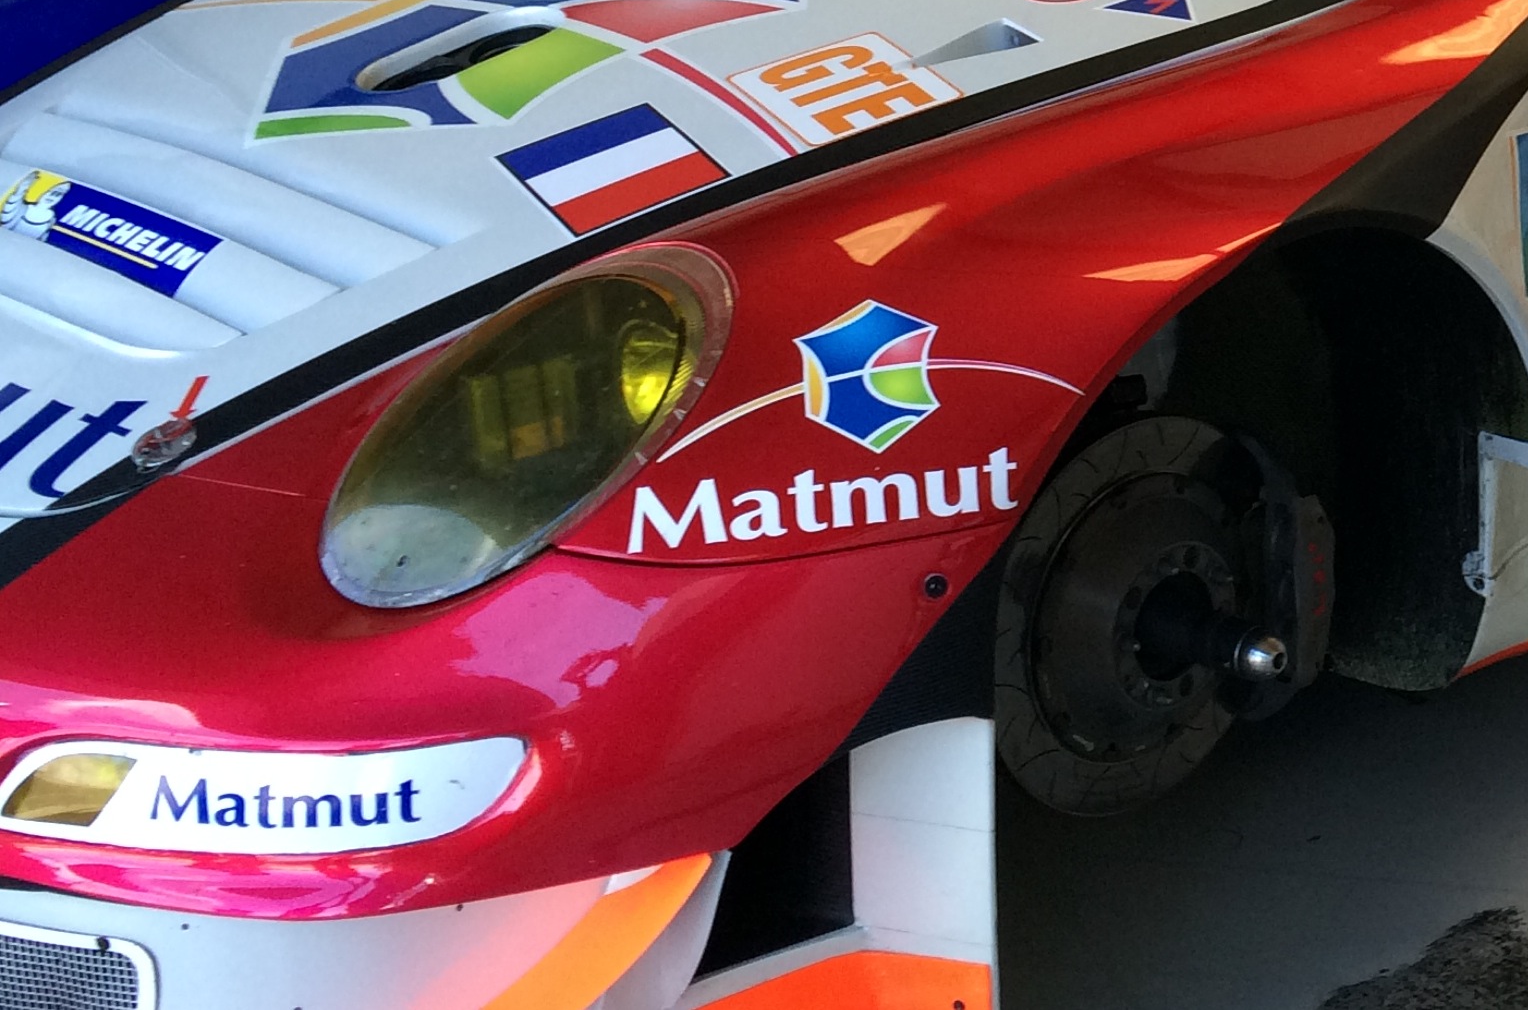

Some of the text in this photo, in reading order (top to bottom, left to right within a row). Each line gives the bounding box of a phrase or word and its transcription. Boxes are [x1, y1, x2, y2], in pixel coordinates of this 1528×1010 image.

[60, 203, 206, 272] MICHELIN
[0, 381, 148, 498] ut
[627, 447, 1018, 555] Matmut
[150, 775, 422, 829] Matmut
